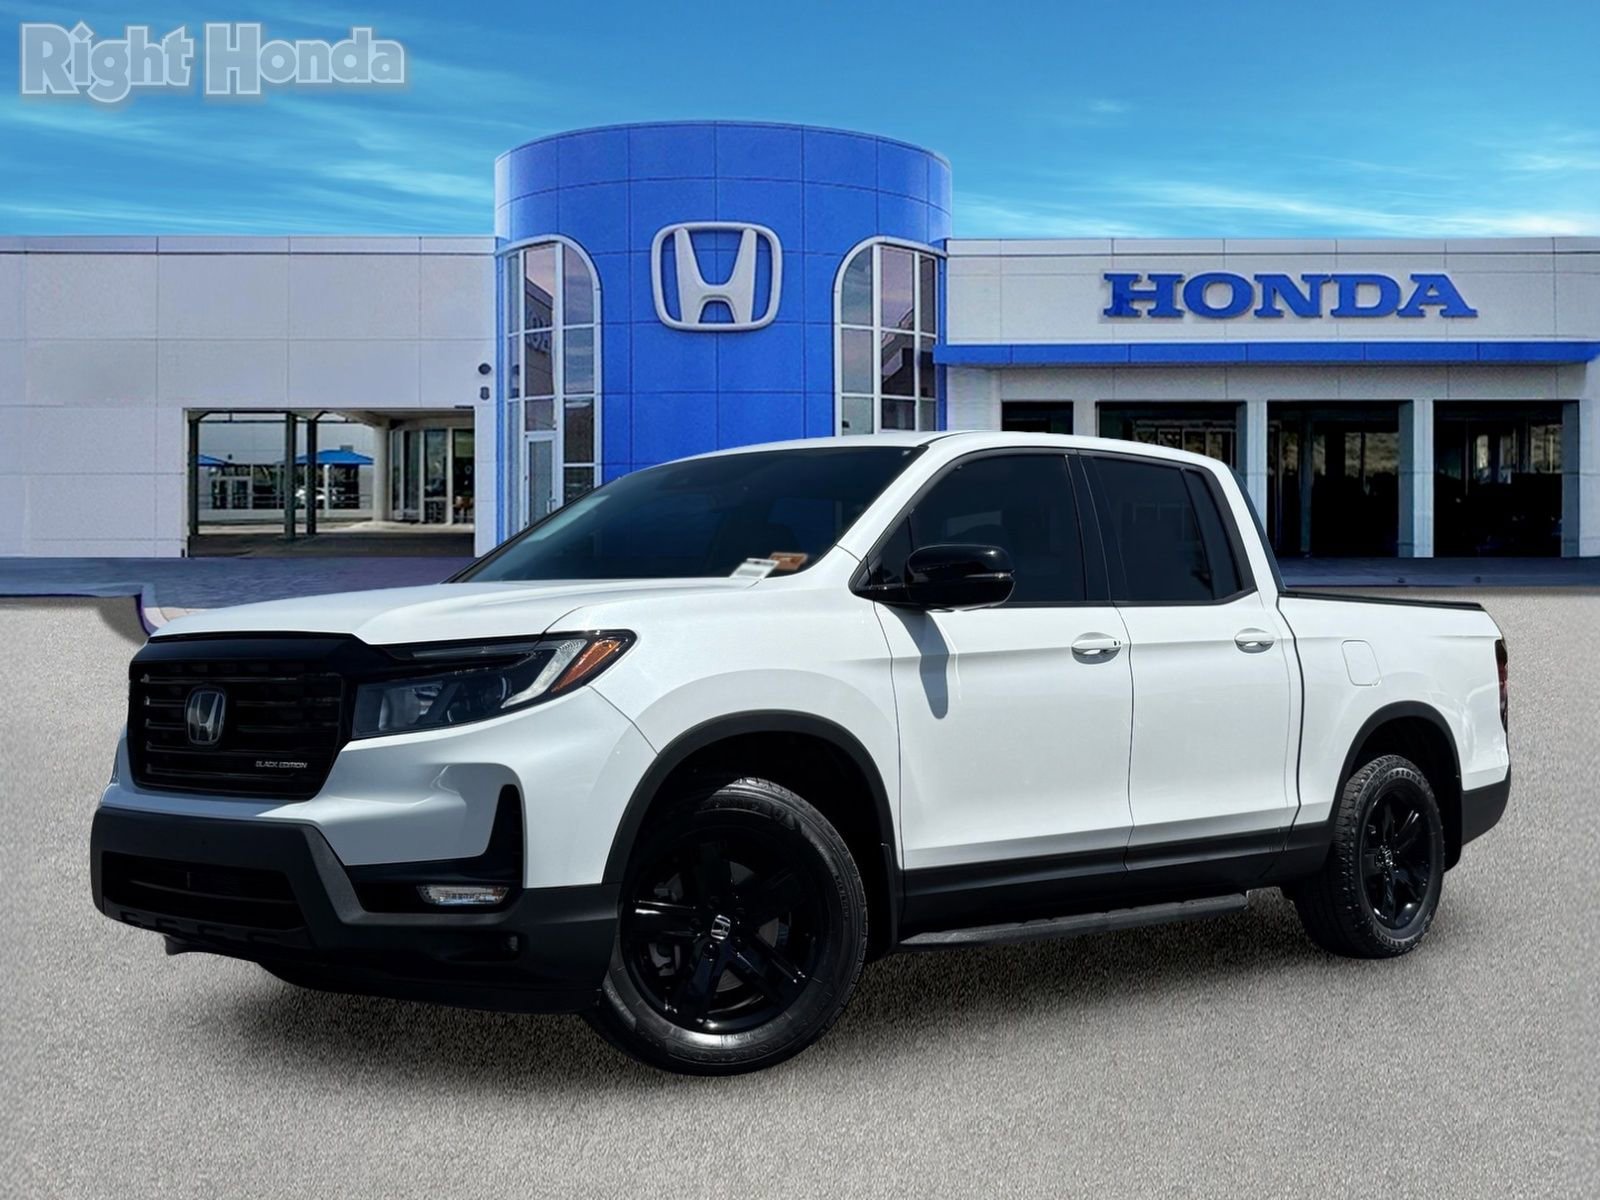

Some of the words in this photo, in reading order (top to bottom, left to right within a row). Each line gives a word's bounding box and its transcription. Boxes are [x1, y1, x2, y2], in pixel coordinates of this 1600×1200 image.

[1103, 272, 1478, 319] HONDA
[255, 760, 278, 768] BLACK
[278, 761, 308, 769] EDITION
